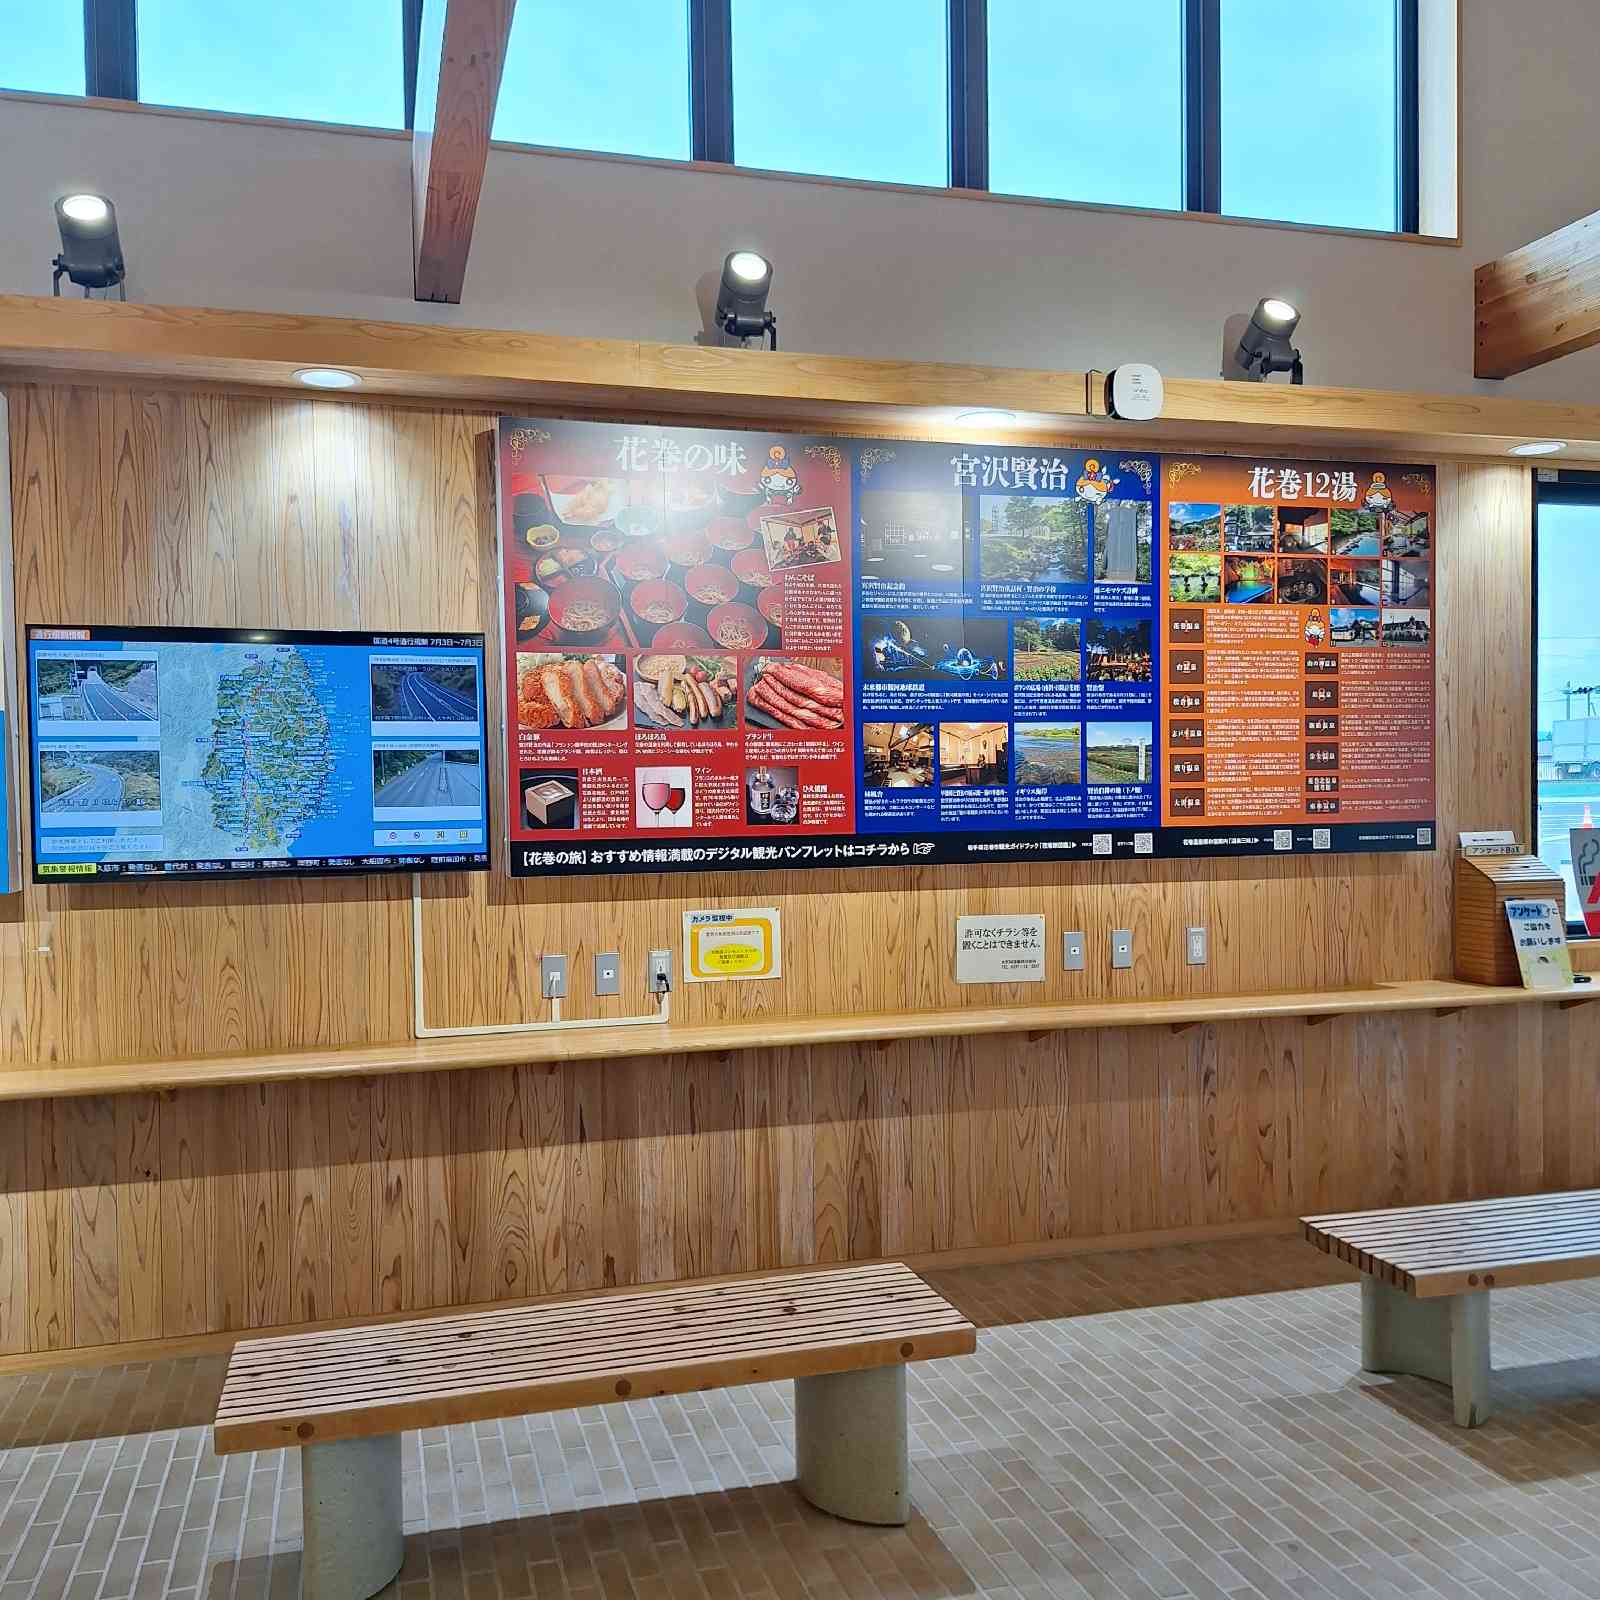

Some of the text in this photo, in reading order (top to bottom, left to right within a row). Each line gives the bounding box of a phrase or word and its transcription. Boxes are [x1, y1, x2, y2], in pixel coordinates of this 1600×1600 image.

[612, 435, 748, 477] 花巻の味
[950, 452, 1069, 491] 宮沢賢治
[1247, 466, 1358, 503] 花巻12湯
[694, 767, 712, 775] ワイン
[961, 939, 1041, 951] 置くことはできません。
[964, 927, 1039, 939] 許可なくチラシ等を
